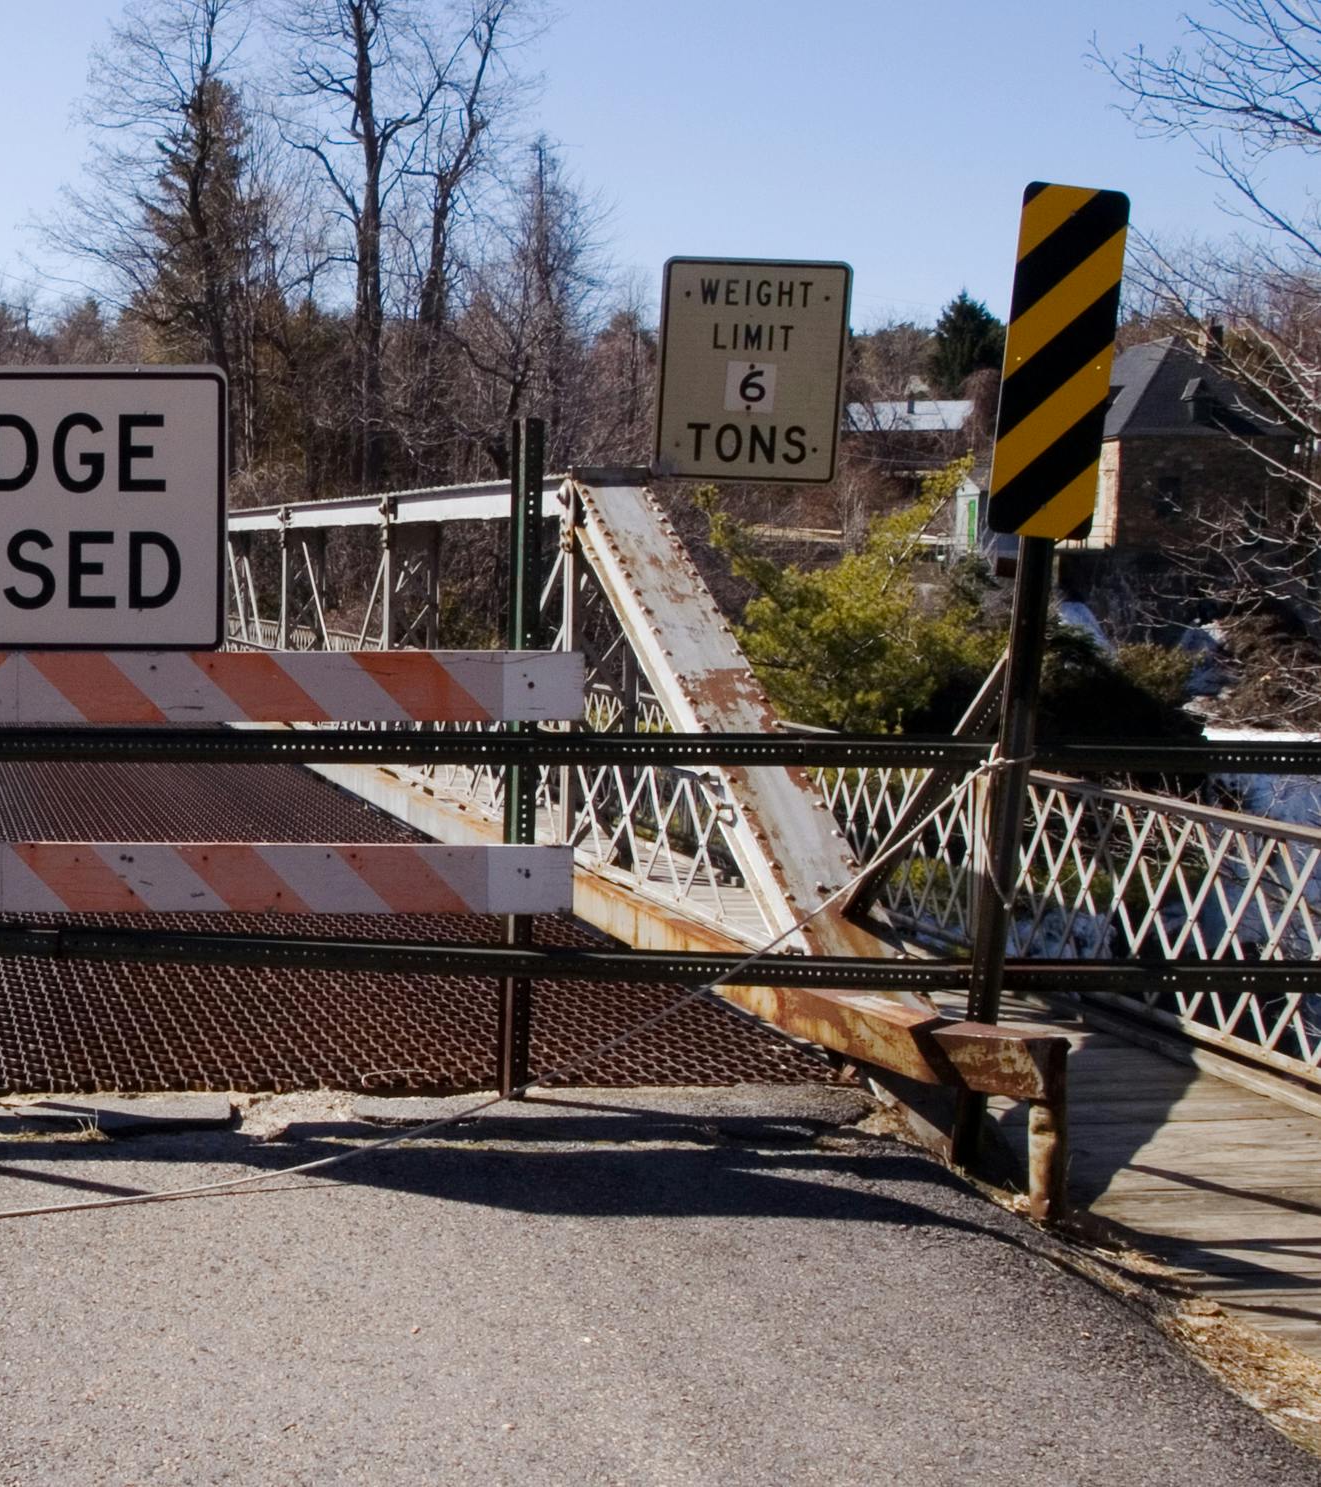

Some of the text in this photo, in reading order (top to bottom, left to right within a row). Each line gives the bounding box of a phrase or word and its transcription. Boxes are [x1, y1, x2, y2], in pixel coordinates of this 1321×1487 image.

[700, 278, 814, 308] WEIGHT
[712, 323, 795, 351] LIMIT
[739, 370, 766, 402] 6
[687, 423, 807, 465] TONS
